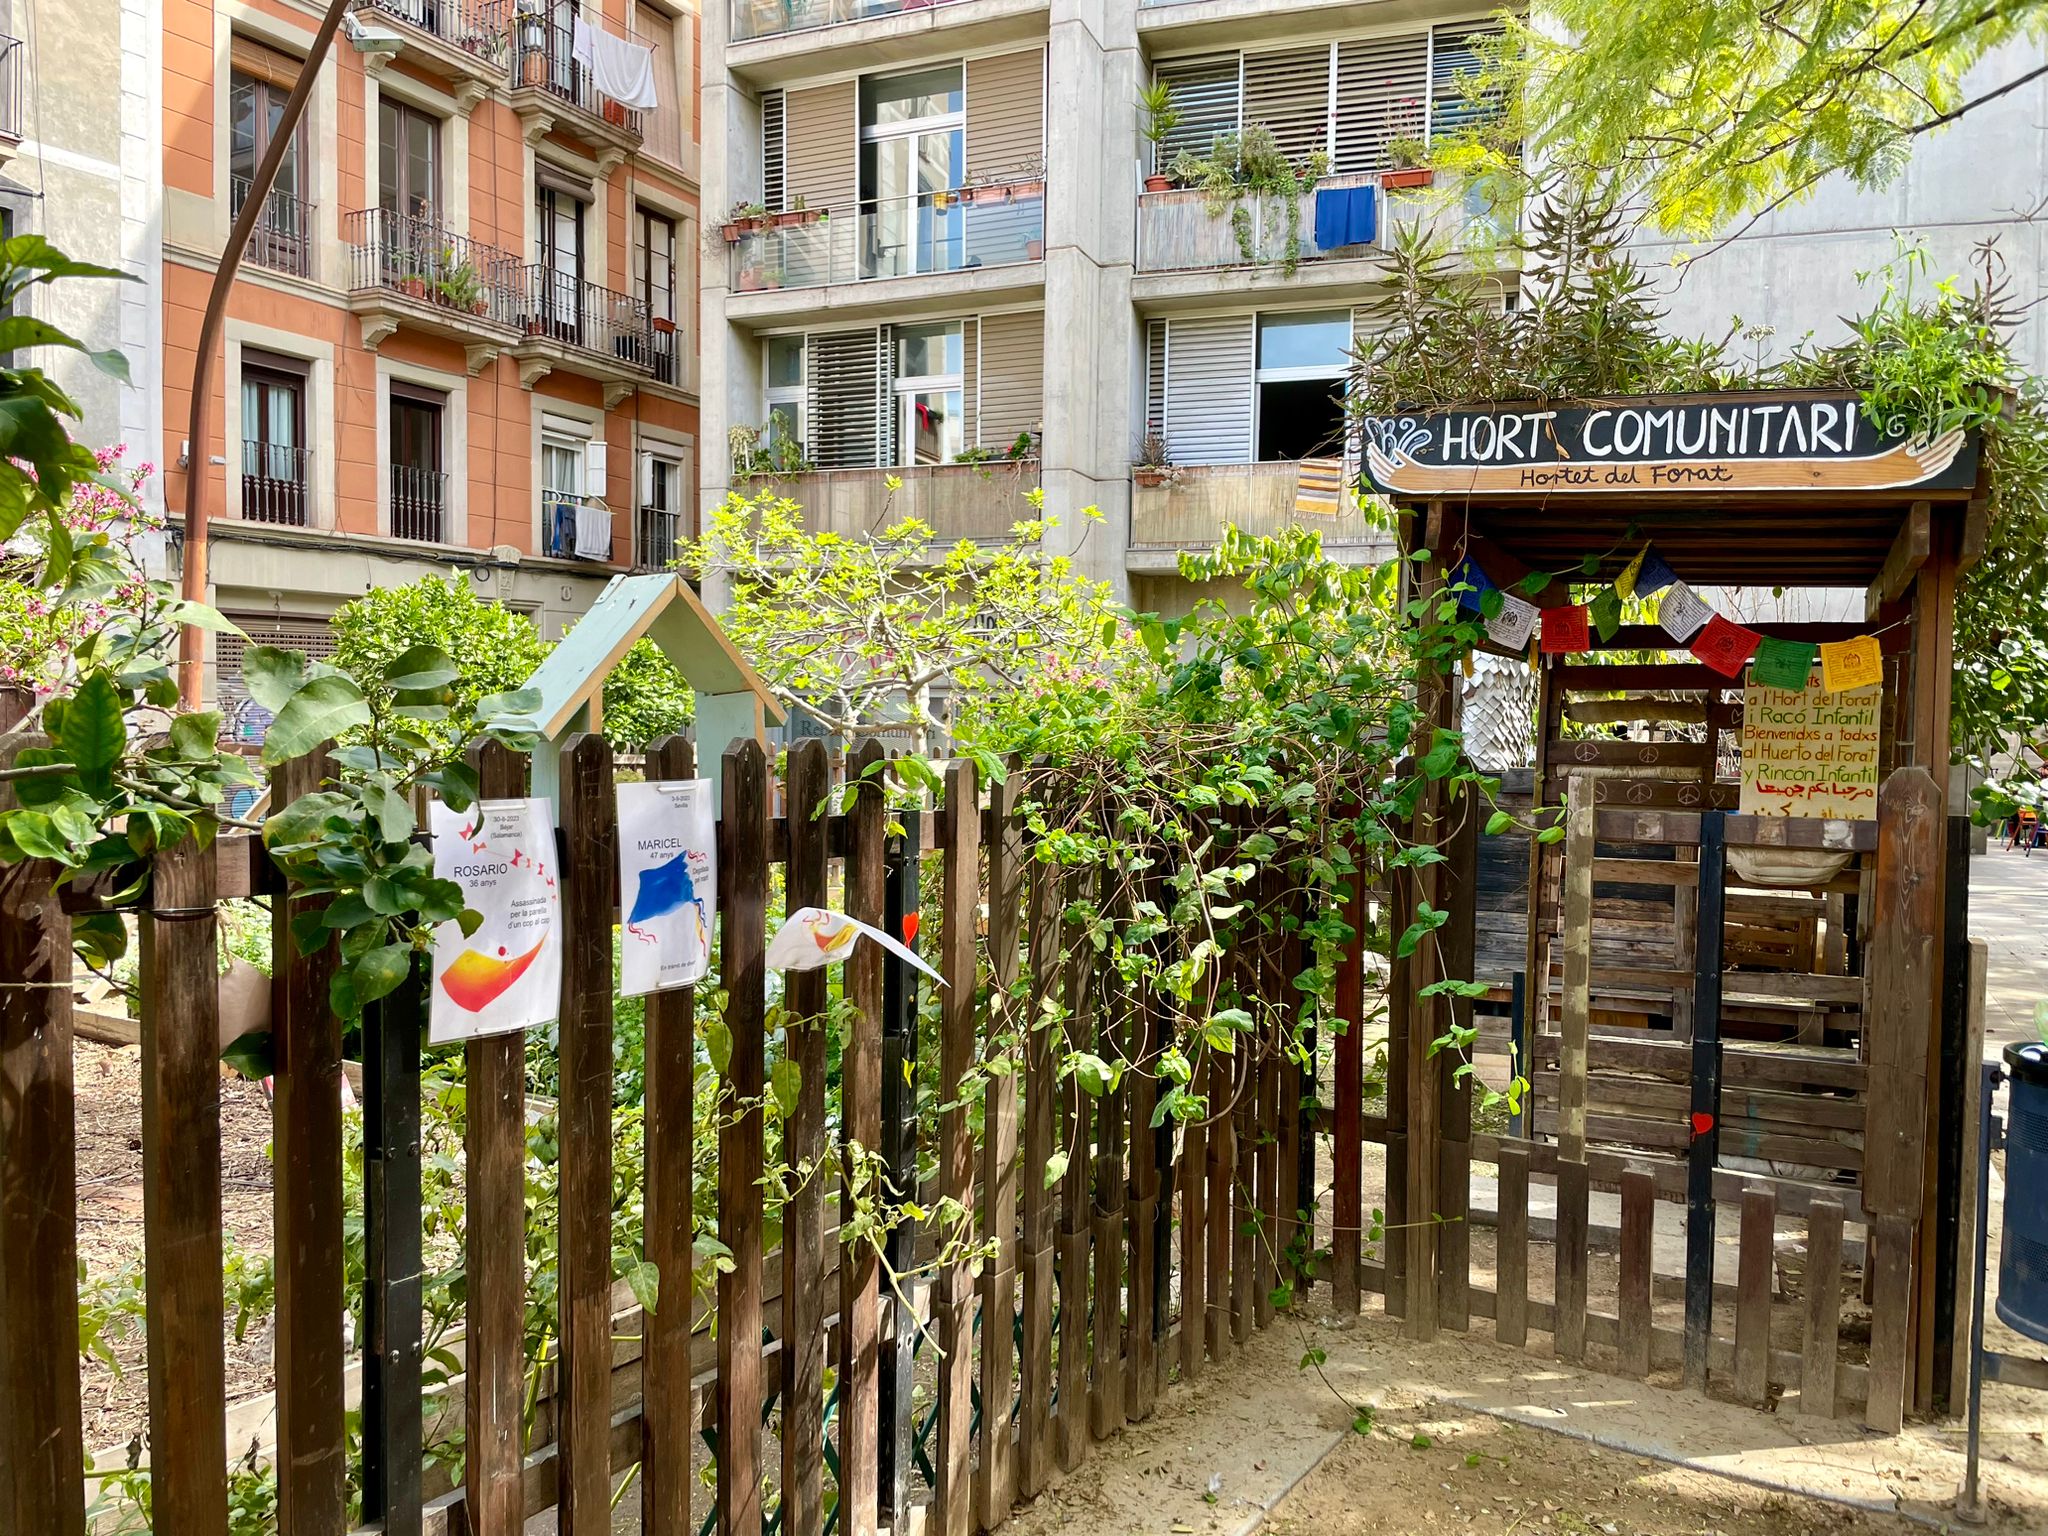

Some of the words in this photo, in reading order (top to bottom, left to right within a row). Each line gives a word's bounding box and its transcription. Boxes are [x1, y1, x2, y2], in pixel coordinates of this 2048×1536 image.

[1442, 411, 1557, 461] HORT
[1583, 402, 1855, 456] COMUNITARI
[1521, 466, 1598, 487] Hortet
[1605, 466, 1640, 485] del
[1651, 464, 1733, 484] Forat
[1749, 696, 1757, 706] a
[1763, 690, 1808, 706] l'Hort
[1812, 692, 1834, 706] del
[1839, 692, 1880, 706] Forat
[1750, 710, 1754, 723] i
[1761, 707, 1806, 724] Racó
[1812, 707, 1875, 725] Infantil
[1744, 725, 1820, 741] Bienvenidxs
[1824, 731, 1833, 741] a
[1840, 728, 1877, 741] todxs
[1743, 742, 1756, 759] al
[1761, 743, 1811, 760] Huerto
[1815, 744, 1834, 761] del
[1838, 745, 1877, 762] Forat
[1744, 771, 1753, 784] y
[1758, 763, 1815, 782] Rincón
[1818, 764, 1877, 783] Infantil
[638, 838, 683, 850] MARICEL
[660, 851, 674, 860] anys
[454, 863, 508, 878] ROSARIO
[469, 880, 479, 888] 36
[480, 879, 497, 889] anys
[510, 911, 521, 919] per
